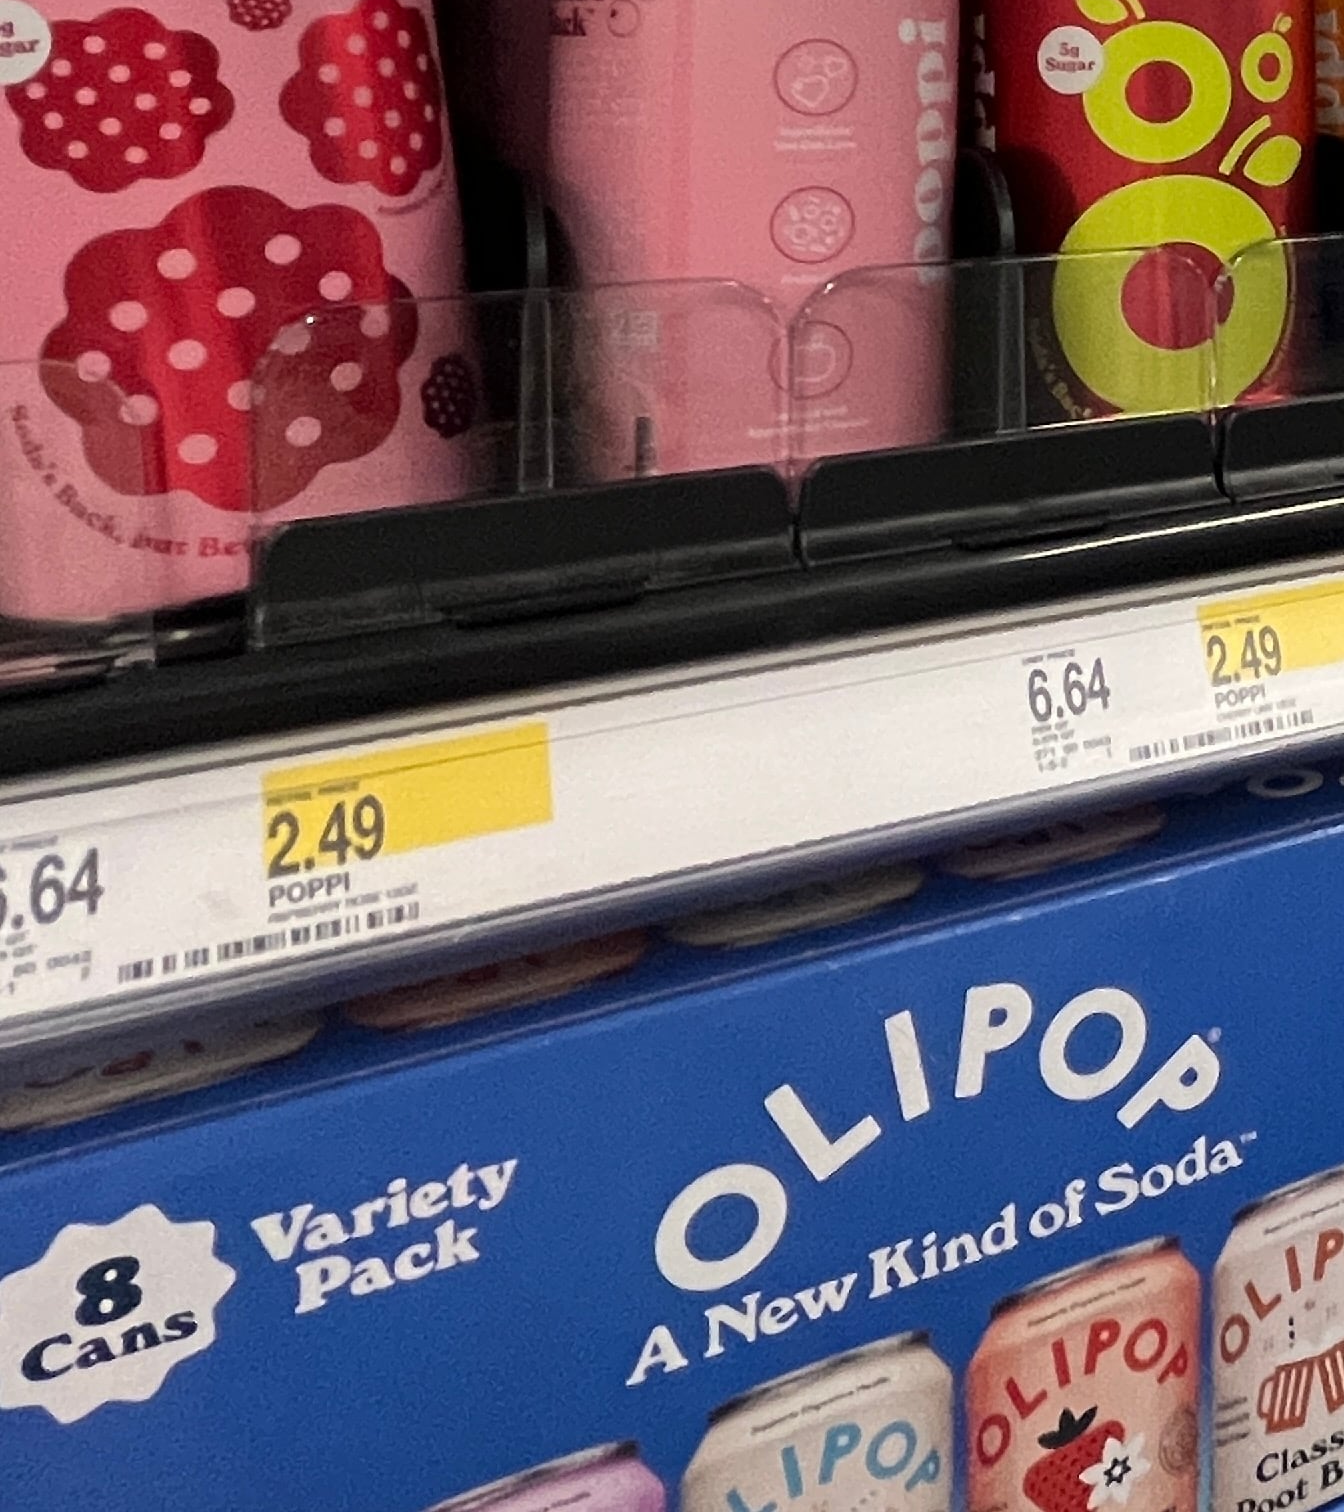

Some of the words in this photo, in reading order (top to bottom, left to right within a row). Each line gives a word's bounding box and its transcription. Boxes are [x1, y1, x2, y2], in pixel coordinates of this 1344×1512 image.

[1045, 56, 1097, 75] Sugar
[1058, 42, 1079, 59] 5g
[1028, 657, 1111, 722] 6.64
[1205, 624, 1283, 688] 2.49
[1214, 683, 1267, 710] POPPI
[267, 793, 386, 880] 2.49
[268, 871, 351, 908] POPPI
[654, 981, 1222, 1293] OLIPOP
[250, 1157, 520, 1263] Variety
[75, 1255, 142, 1327] 8
[293, 1218, 482, 1315] Pack
[624, 1324, 688, 1387] A
[703, 1271, 860, 1359] New
[867, 1219, 1019, 1300] Kind
[1027, 1188, 1088, 1241] of
[20, 1310, 199, 1383] Cans
[975, 1315, 1191, 1469] OLIPOP
